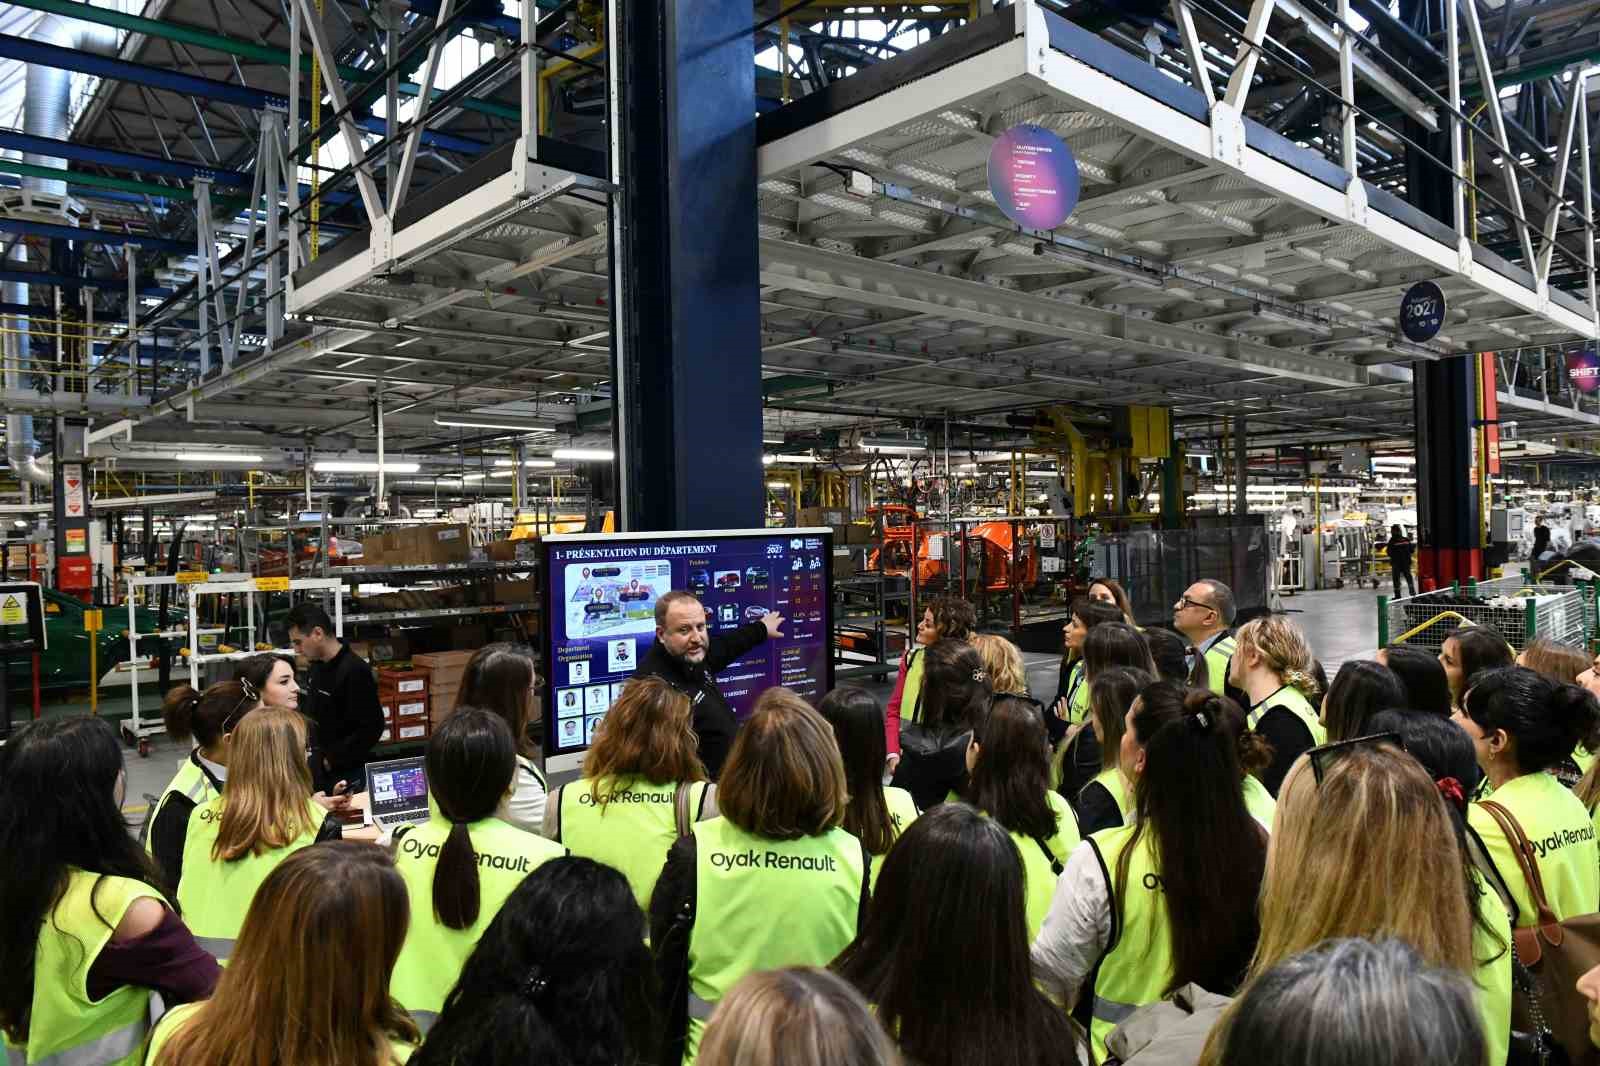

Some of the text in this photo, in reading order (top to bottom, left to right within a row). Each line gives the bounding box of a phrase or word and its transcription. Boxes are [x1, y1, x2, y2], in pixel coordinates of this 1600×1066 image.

[1406, 300, 1437, 318] 2027
[1569, 367, 1599, 377] SHIFT
[565, 547, 638, 559] PRÉSENTATION
[639, 546, 653, 556] DU
[654, 544, 718, 556] DÉPARTEMENT
[622, 791, 673, 803] Renaul
[200, 808, 224, 823] Oya
[403, 838, 530, 873] Oya enault
[710, 849, 836, 872] Oyak Renault
